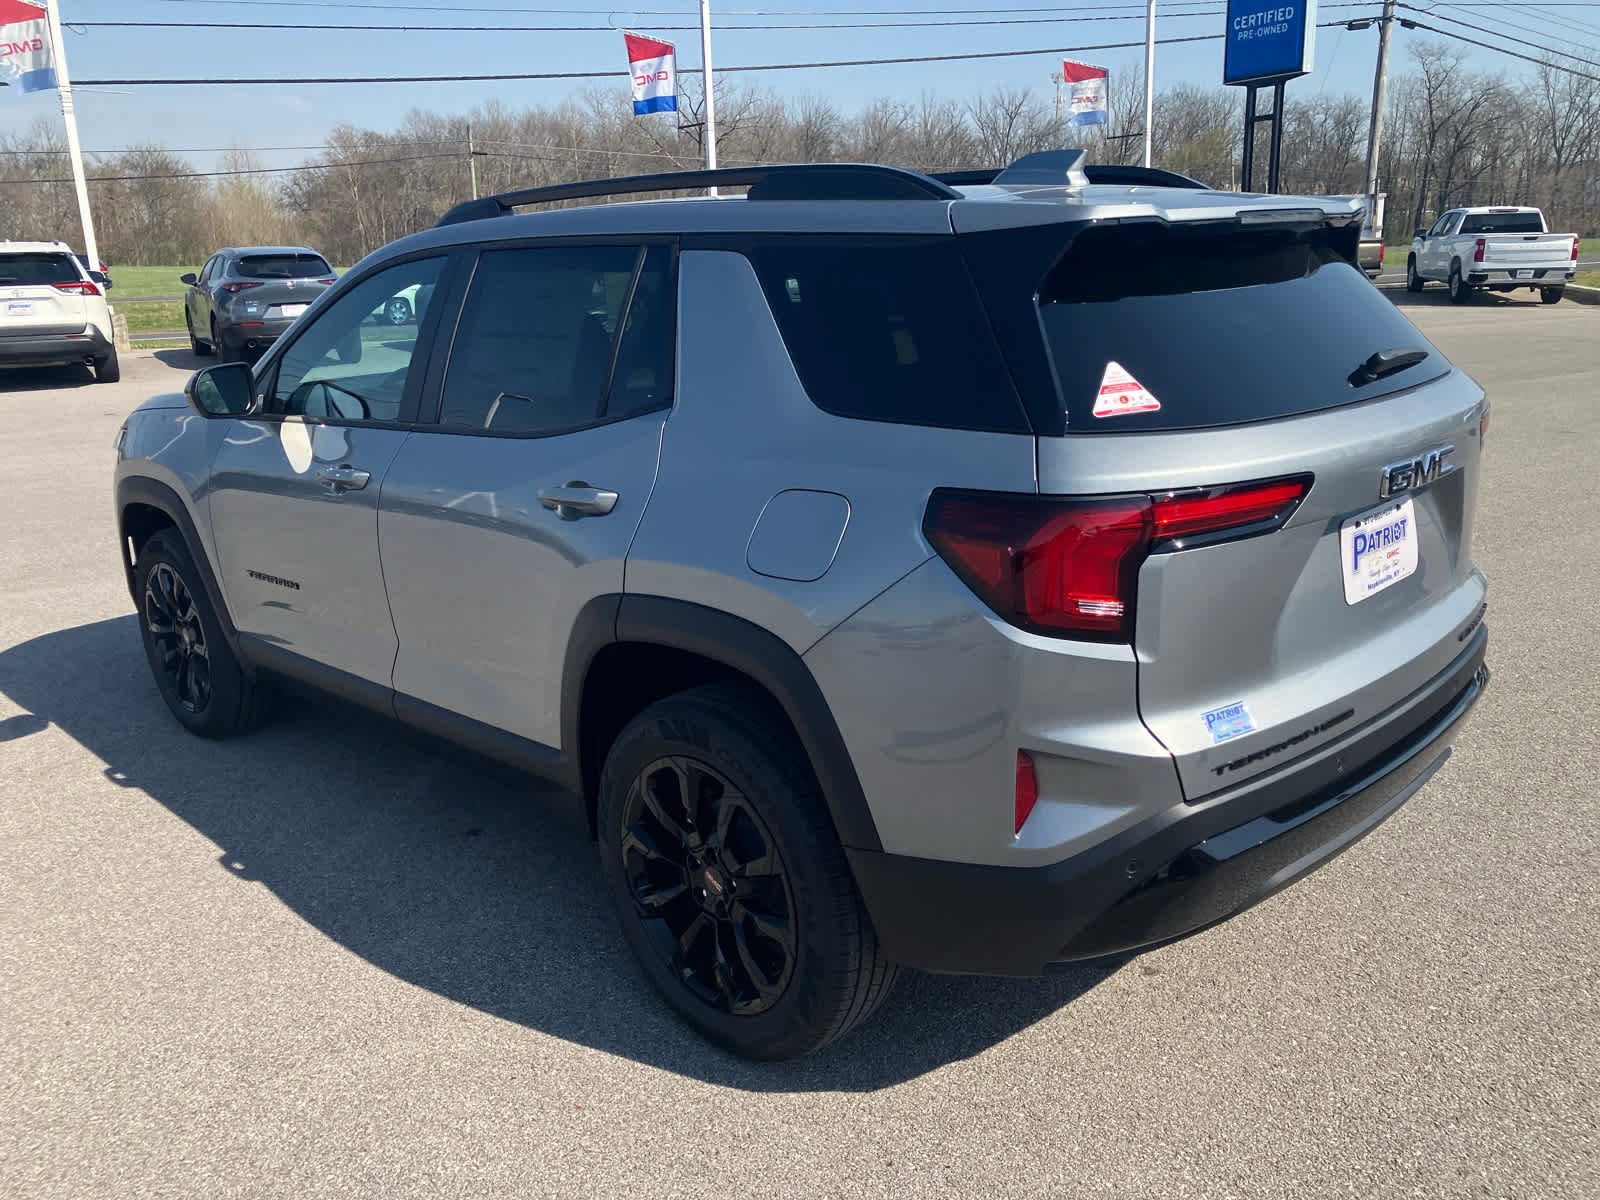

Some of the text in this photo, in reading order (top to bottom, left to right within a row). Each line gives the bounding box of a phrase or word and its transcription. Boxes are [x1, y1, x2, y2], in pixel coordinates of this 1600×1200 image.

[1233, 7, 1294, 31] CERTIFIED
[1237, 23, 1288, 41] PRE-OWNED
[1380, 445, 1456, 499] GMC
[1353, 519, 1407, 571] PATRIOT
[1206, 703, 1244, 729] PATRIOT
